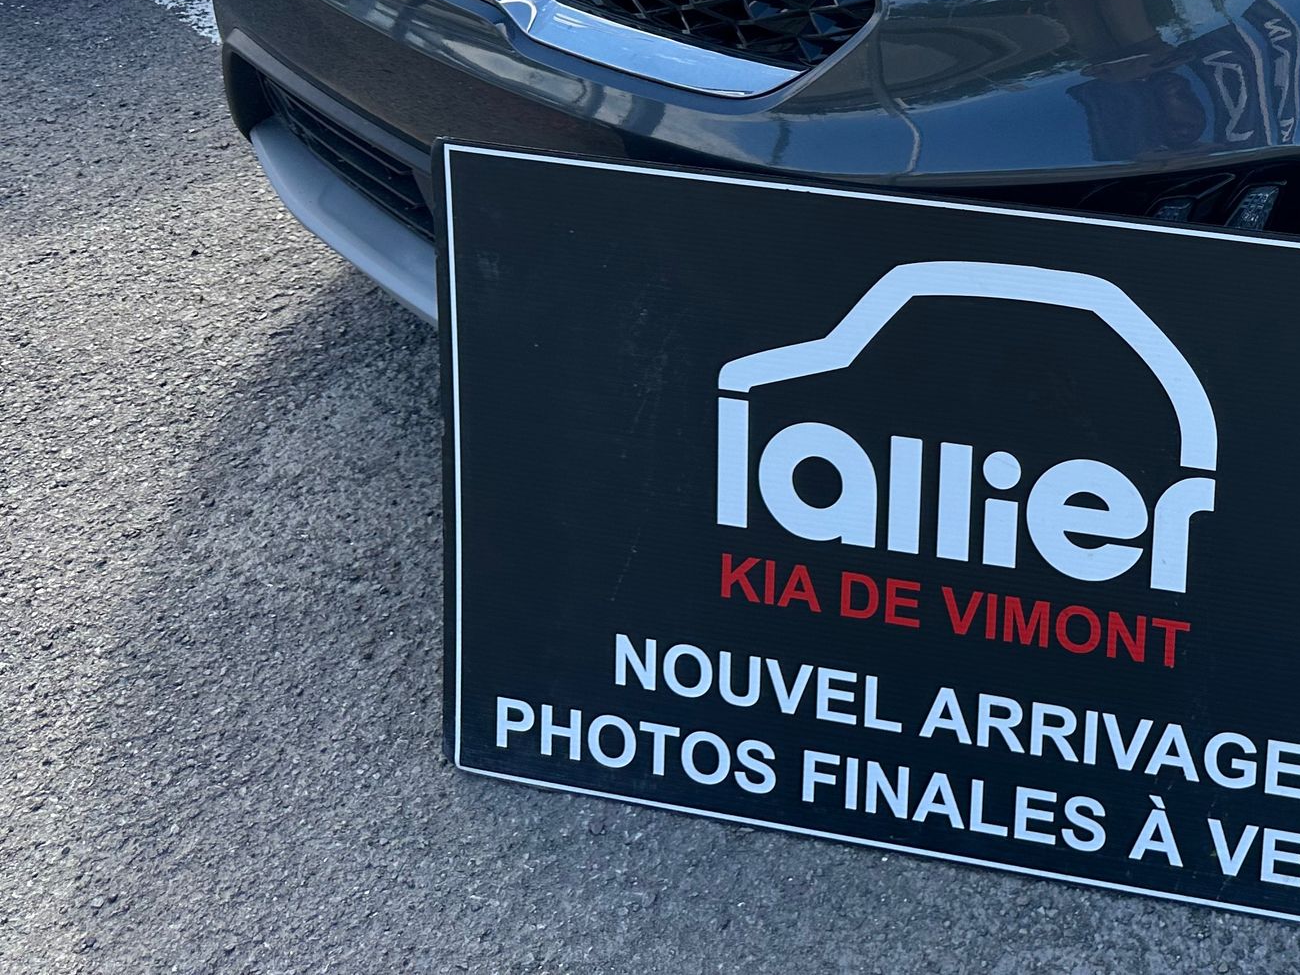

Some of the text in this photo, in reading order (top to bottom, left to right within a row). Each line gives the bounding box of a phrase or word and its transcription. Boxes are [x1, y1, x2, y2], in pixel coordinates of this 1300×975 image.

[720, 553, 1192, 668] KIA DE VIMONT
[614, 633, 903, 733] NOUVEL
[496, 696, 777, 795] PHOTOS
[802, 749, 1106, 853] FINALES
[1128, 794, 1184, 868] À
